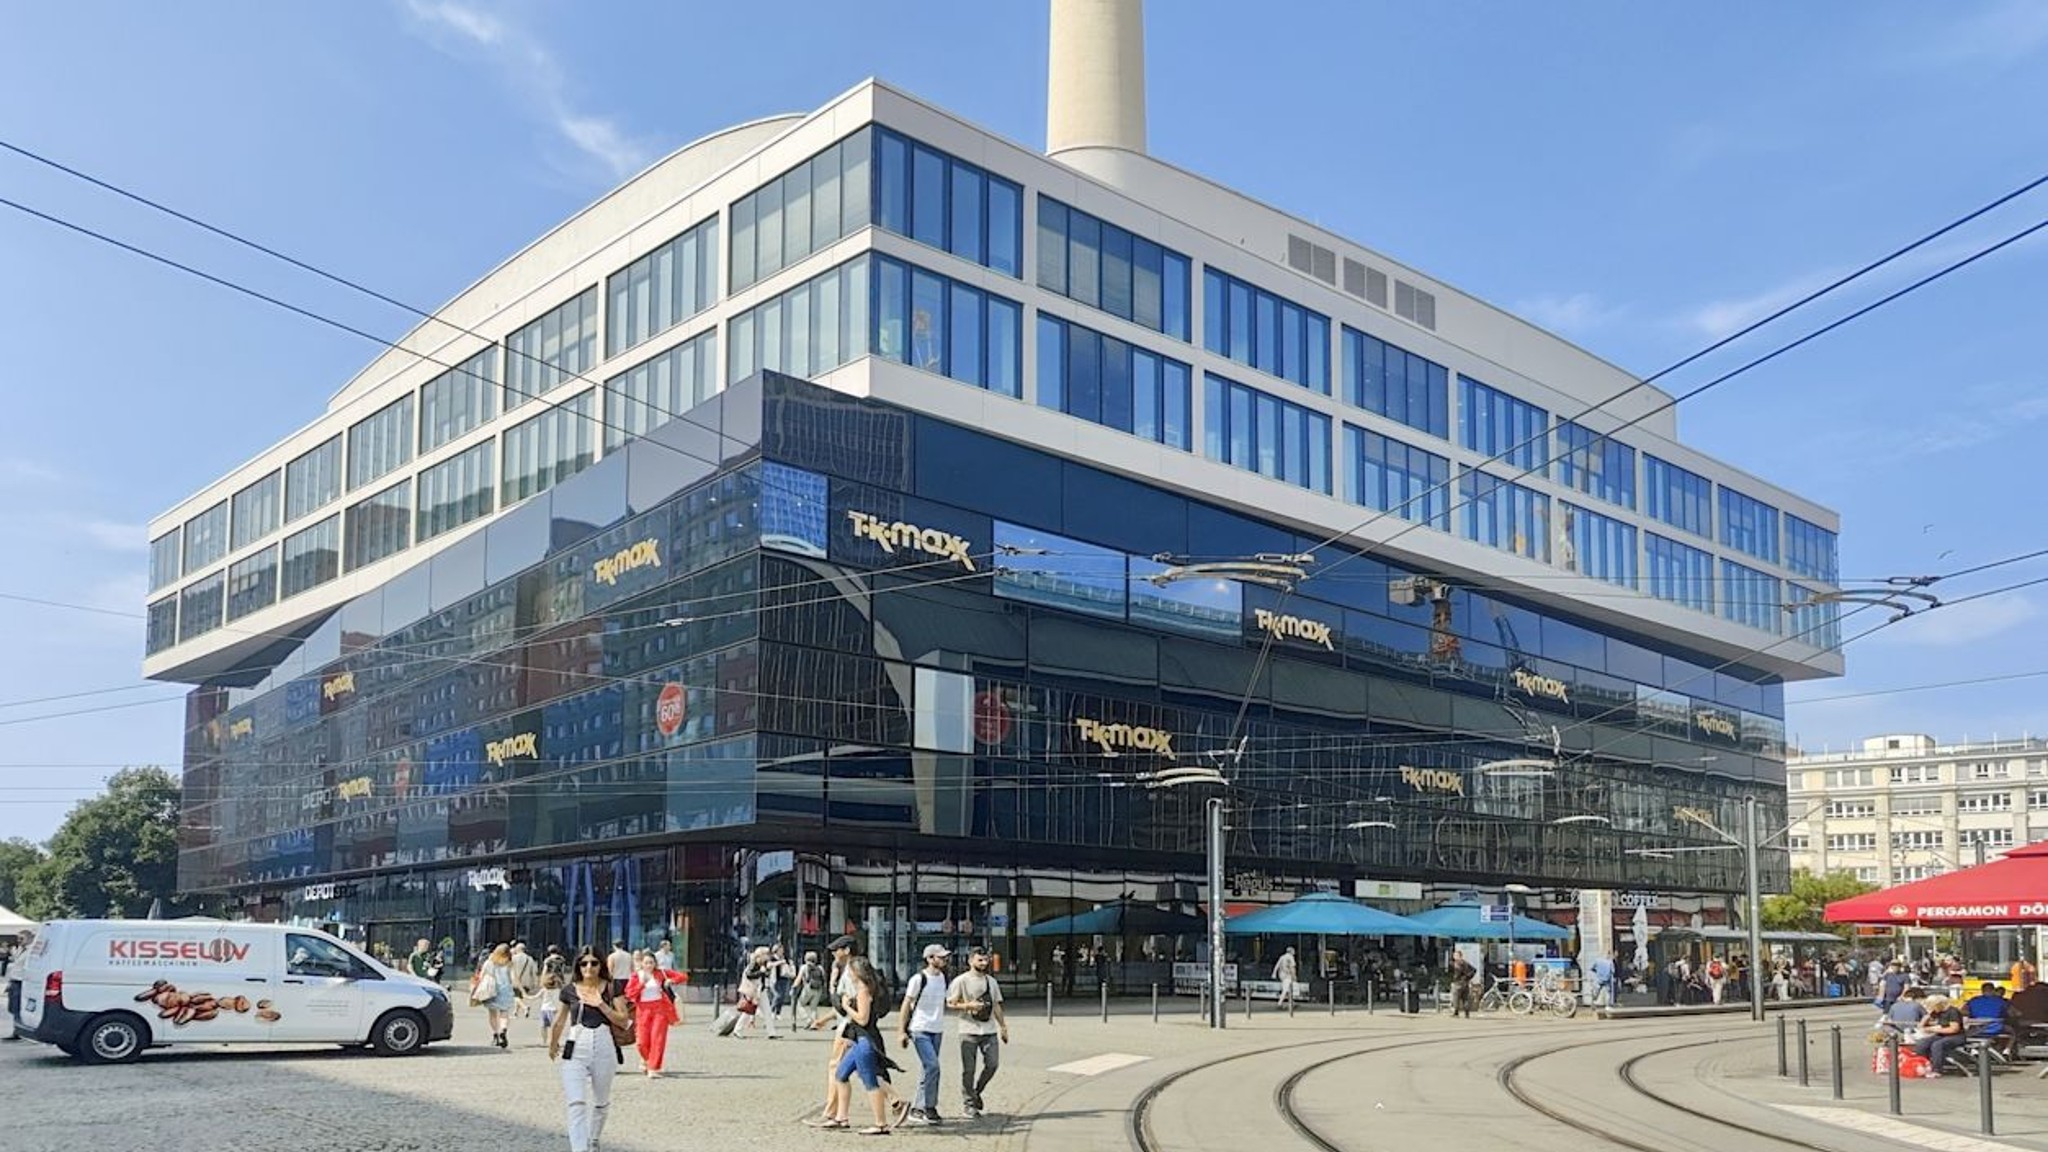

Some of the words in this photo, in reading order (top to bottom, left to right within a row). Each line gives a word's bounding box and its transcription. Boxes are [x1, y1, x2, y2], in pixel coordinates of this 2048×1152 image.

[305, 883, 335, 901] DEPOT
[1917, 904, 2009, 917] PERGAMON
[2019, 902, 2048, 916] DÖ
[109, 938, 250, 963] KISSELOV
